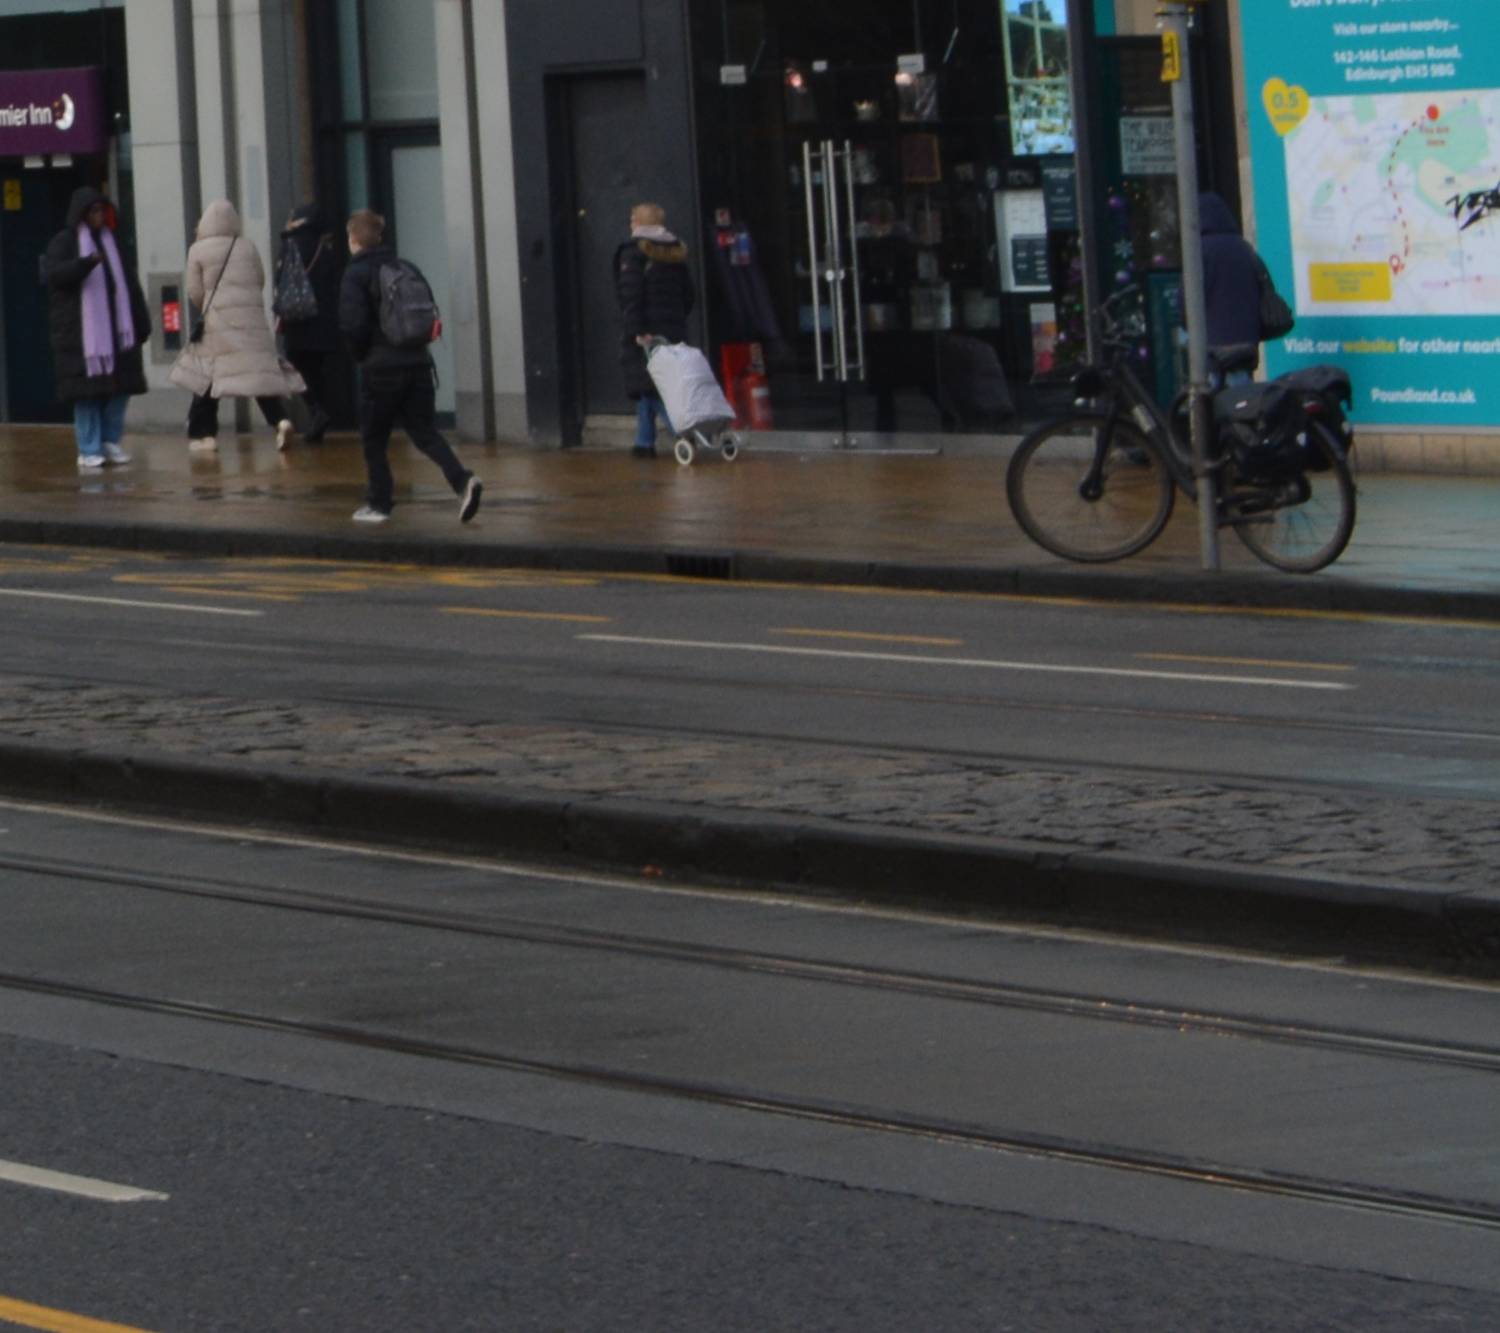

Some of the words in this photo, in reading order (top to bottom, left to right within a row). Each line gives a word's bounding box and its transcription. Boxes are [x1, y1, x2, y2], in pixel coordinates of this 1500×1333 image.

[1333, 22, 1358, 36] Visit
[1360, 23, 1378, 34] our
[1379, 20, 1407, 34] store
[1380, 46, 1425, 62] Lothian
[1345, 65, 1404, 83] Edinburgh
[1271, 91, 1299, 109] 0.5
[29, 104, 52, 125] Inn
[1284, 339, 1314, 353] Visit
[1317, 341, 1340, 353] our
[1398, 338, 1420, 353] for
[1421, 338, 1460, 353] other
